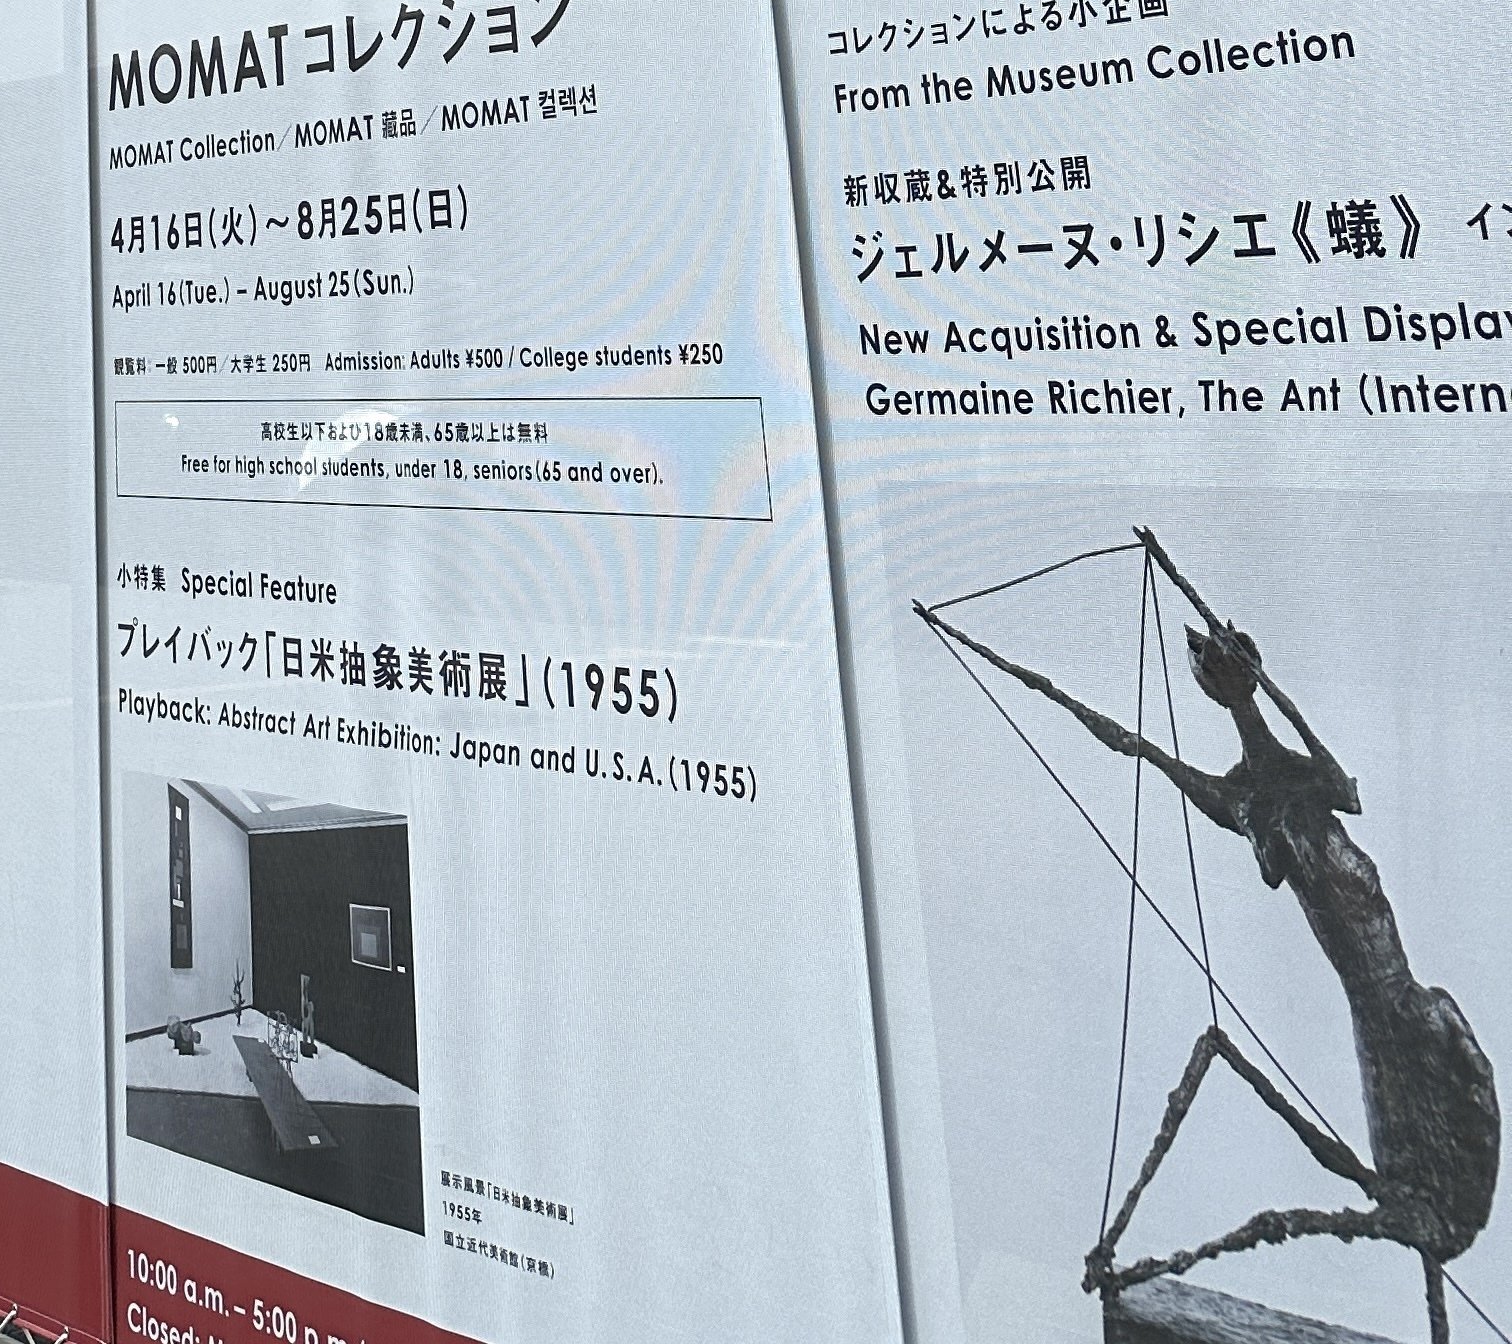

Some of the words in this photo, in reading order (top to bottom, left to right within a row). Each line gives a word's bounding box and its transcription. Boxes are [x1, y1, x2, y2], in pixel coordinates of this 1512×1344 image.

[834, 82, 910, 113] From
[921, 71, 973, 106] the
[986, 56, 1134, 98] Museum
[1147, 27, 1356, 80] Collection
[109, 140, 173, 170] MOMAT
[180, 129, 275, 162] Collection
[294, 114, 374, 148] MOMAT
[442, 96, 530, 131] MOMAT
[538, 84, 598, 119] 컬렉션
[843, 154, 1092, 208] 新収蔵&特別公開
[850, 193, 1421, 283] ジェルメーヌ・リシエ《蟻》
[112, 282, 151, 313] April
[253, 272, 323, 306] August
[860, 324, 928, 355] New
[944, 316, 1140, 358] Acquisition
[1155, 316, 1178, 347] &
[1193, 305, 1349, 353] Special
[155, 356, 178, 375] 一般
[182, 355, 218, 374] 500円
[230, 354, 268, 374] 大学生
[272, 353, 311, 373] 250円
[325, 350, 406, 372] Admission:
[409, 348, 460, 370] Adults
[465, 347, 504, 369] ¥500
[519, 346, 589, 372] College
[595, 343, 672, 366] students
[678, 342, 724, 365] ¥250
[865, 383, 1033, 416] Germaine
[1048, 381, 1185, 418] Richier,
[1199, 379, 1263, 412] The
[1280, 377, 1341, 412] Ant
[1359, 372, 1512, 416] (Intern
[181, 454, 210, 473] Free
[213, 454, 232, 474] for
[235, 454, 265, 479] high
[269, 456, 318, 476] school
[322, 456, 390, 480] students,
[395, 458, 437, 480] under
[443, 458, 469, 482] 18,
[567, 461, 603, 483] and
[610, 462, 664, 485] over).
[116, 561, 166, 593] 小特集
[181, 567, 254, 600] Special
[260, 572, 337, 605] Feature
[118, 687, 212, 728] Playback:
[218, 701, 296, 738] Abstract
[303, 709, 331, 742] Art
[338, 717, 442, 757] Exhibition:
[449, 730, 521, 770] Japan
[530, 736, 576, 776] and
[442, 1200, 483, 1225] 1955年
[127, 1249, 178, 1296] 10:00
[184, 1278, 230, 1318] a.m.
[252, 1298, 297, 1344] 5:00
